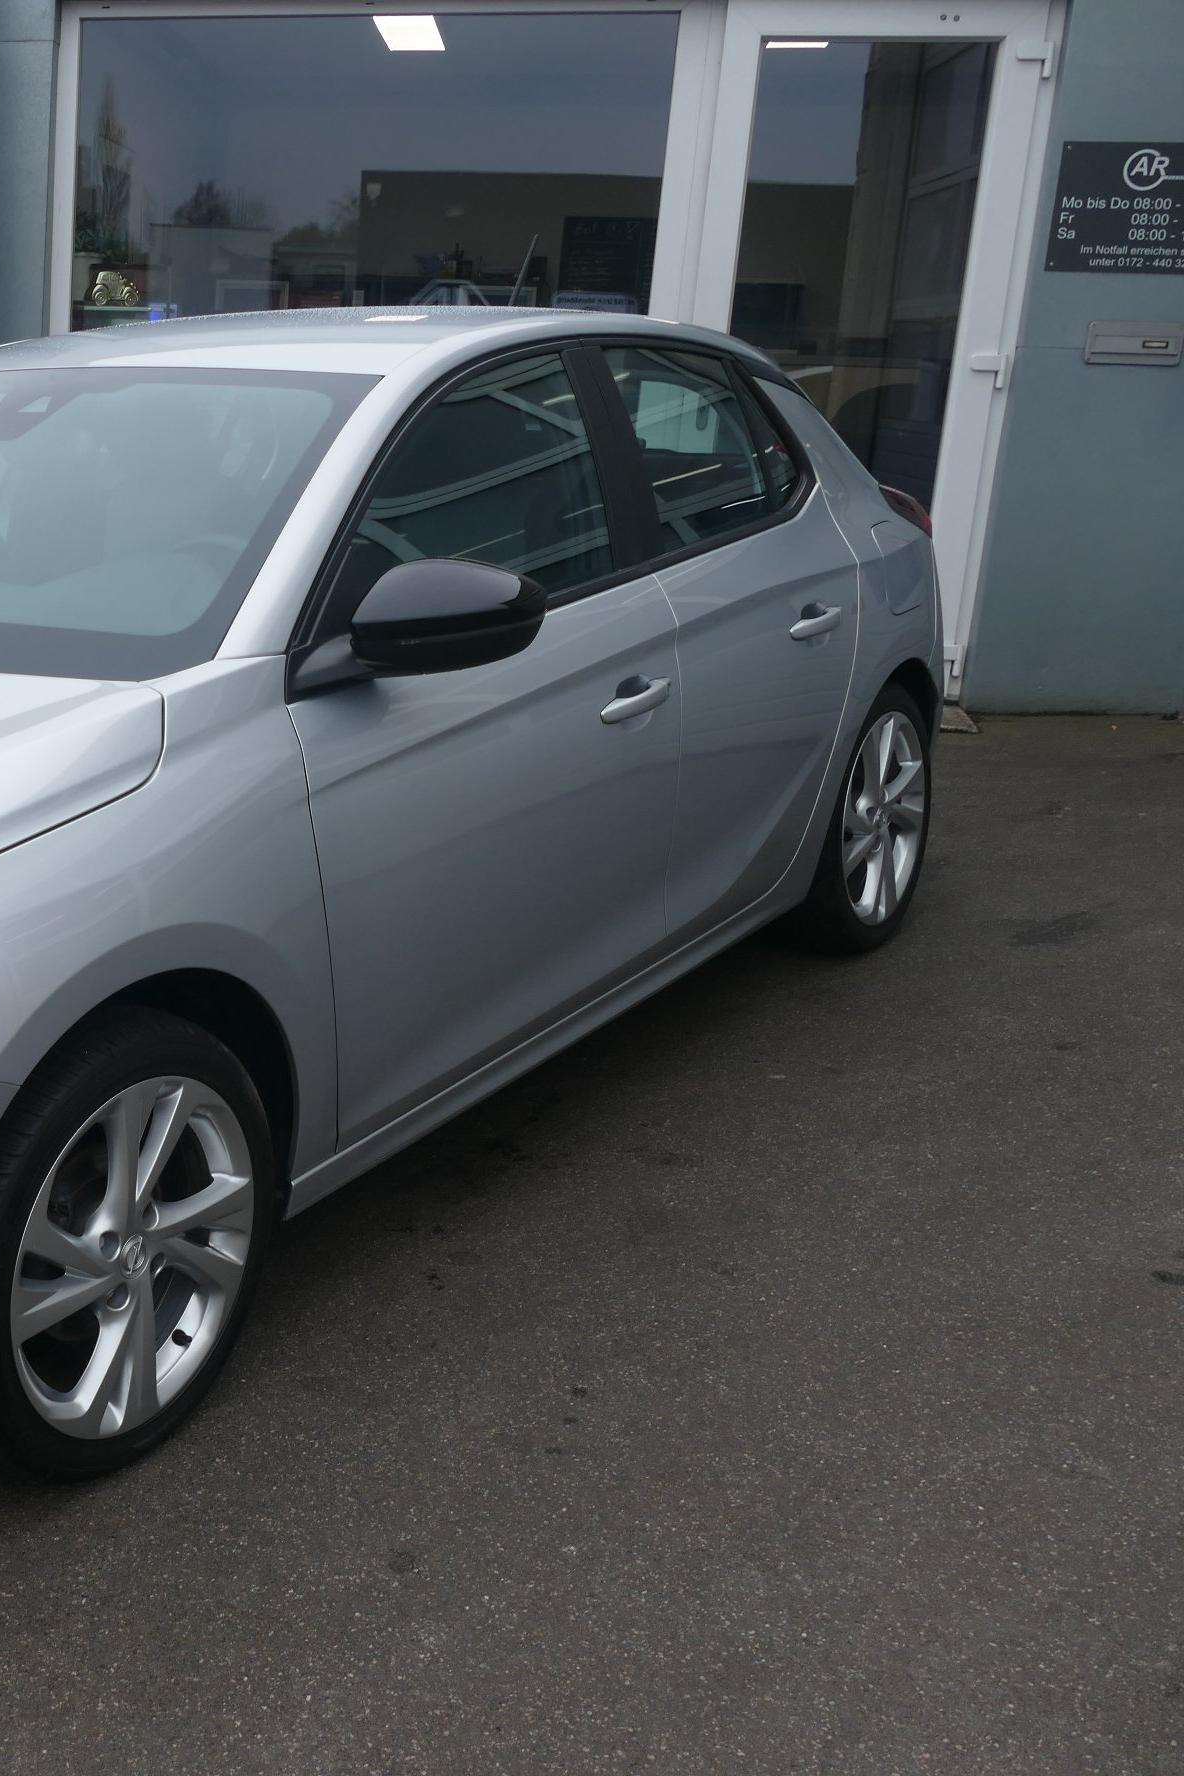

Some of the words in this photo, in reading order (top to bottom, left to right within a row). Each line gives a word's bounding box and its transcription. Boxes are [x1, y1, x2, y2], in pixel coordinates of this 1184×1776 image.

[1062, 197, 1083, 209] Mo
[1086, 197, 1106, 209] bis
[1110, 197, 1130, 209] Do
[1133, 198, 1173, 210] 08:00
[1059, 212, 1075, 224] Fr
[1131, 213, 1170, 226] 08:00
[1057, 227, 1076, 240] Sa
[1128, 229, 1167, 241] 08:00
[1080, 244, 1093, 254] Im
[1095, 245, 1128, 255] Notfall
[1130, 246, 1178, 256] erreichen
[1089, 258, 1116, 267] unter
[1117, 258, 1144, 268] 0172
[1152, 259, 1173, 268] 440
